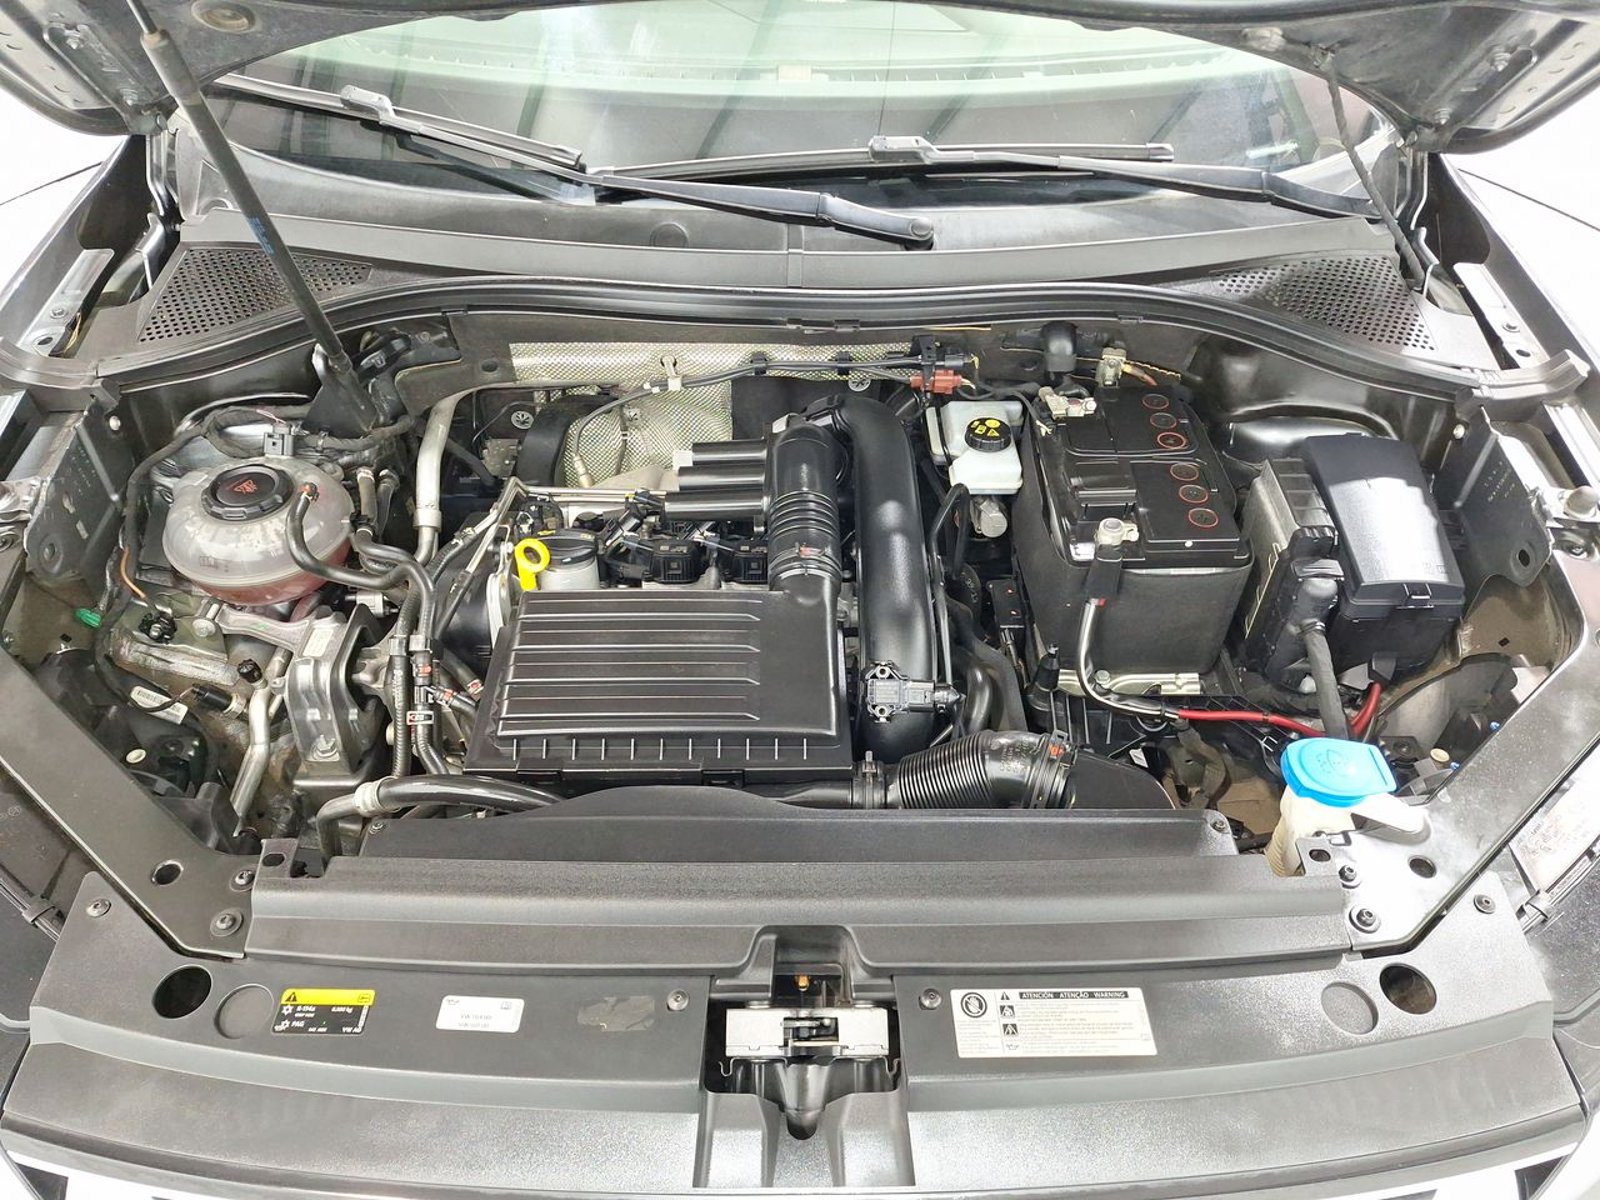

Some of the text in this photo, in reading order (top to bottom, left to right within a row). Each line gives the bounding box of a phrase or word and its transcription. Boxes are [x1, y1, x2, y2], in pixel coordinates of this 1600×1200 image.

[1021, 990, 1126, 1000] ATENCIÓN ATENÇÃO WARNING
